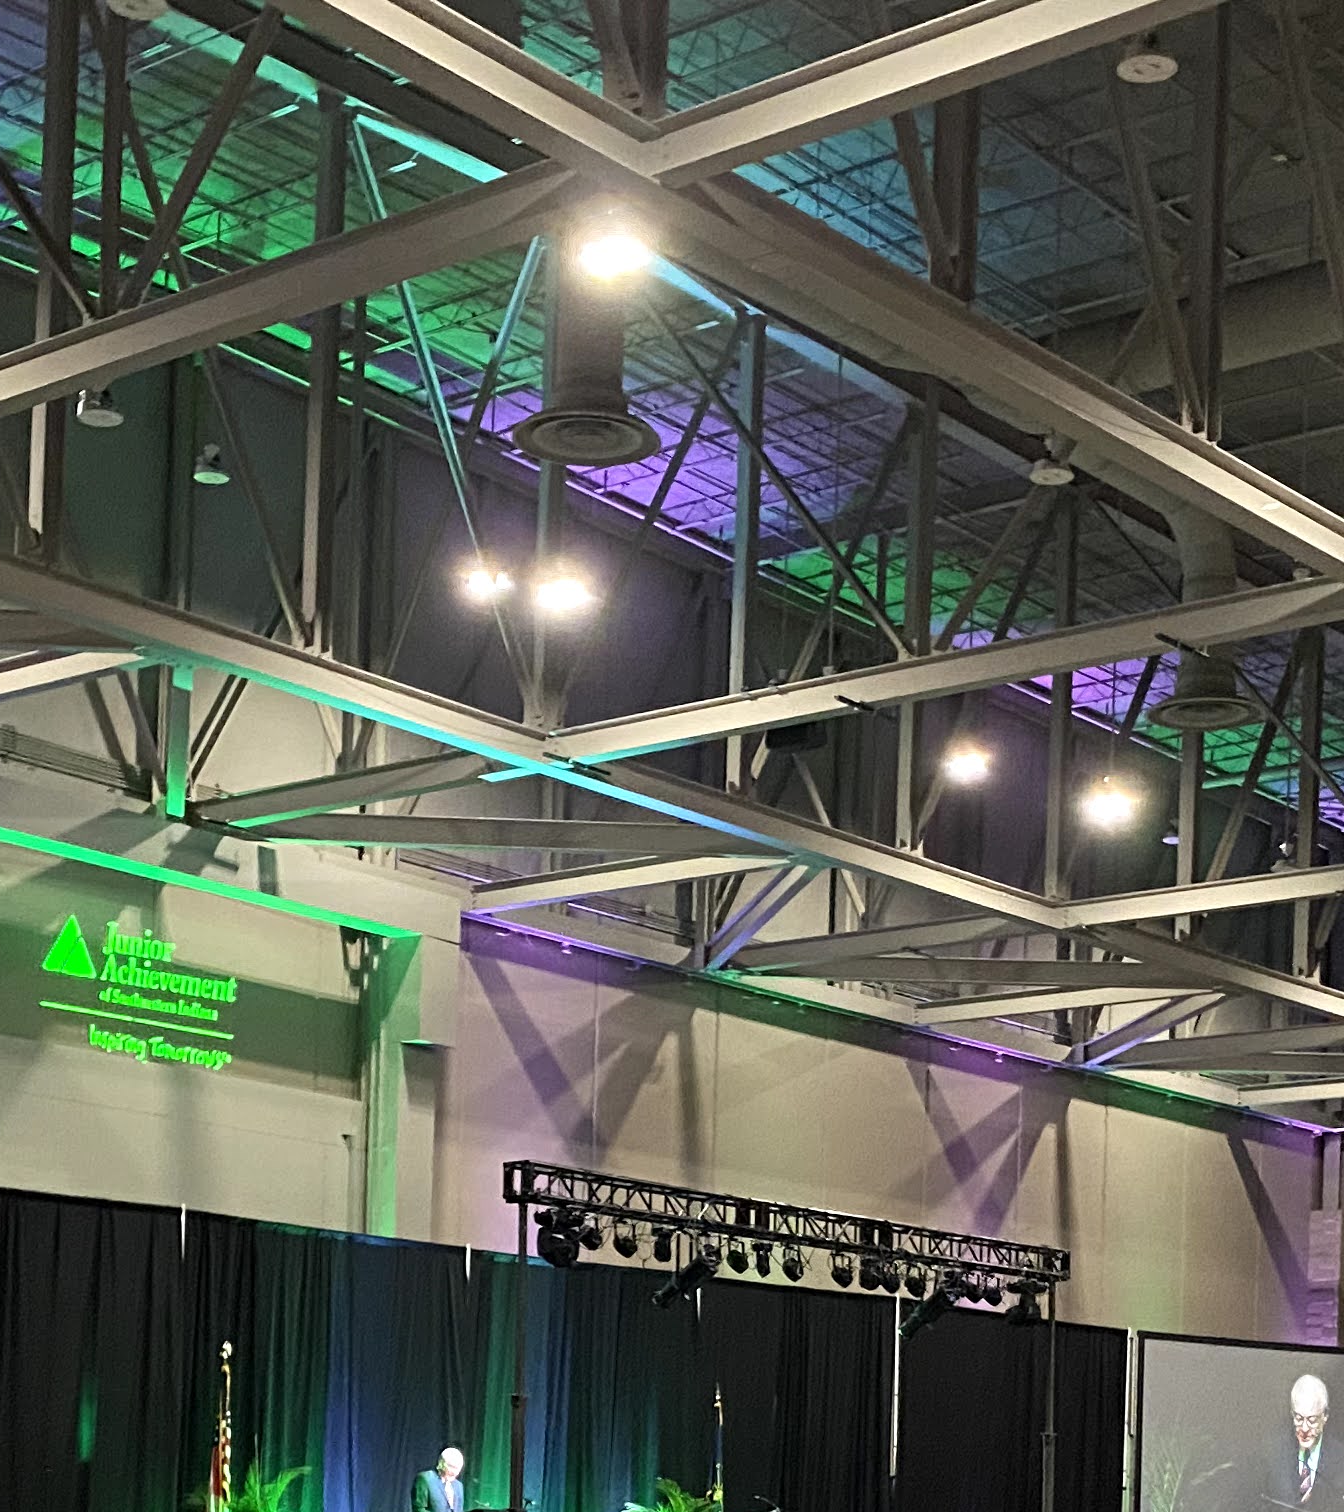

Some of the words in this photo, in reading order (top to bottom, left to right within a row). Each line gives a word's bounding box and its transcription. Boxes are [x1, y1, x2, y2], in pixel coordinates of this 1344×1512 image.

[102, 921, 176, 962] Junior
[100, 954, 237, 1003] Achievement
[89, 1024, 147, 1062] Inspiring
